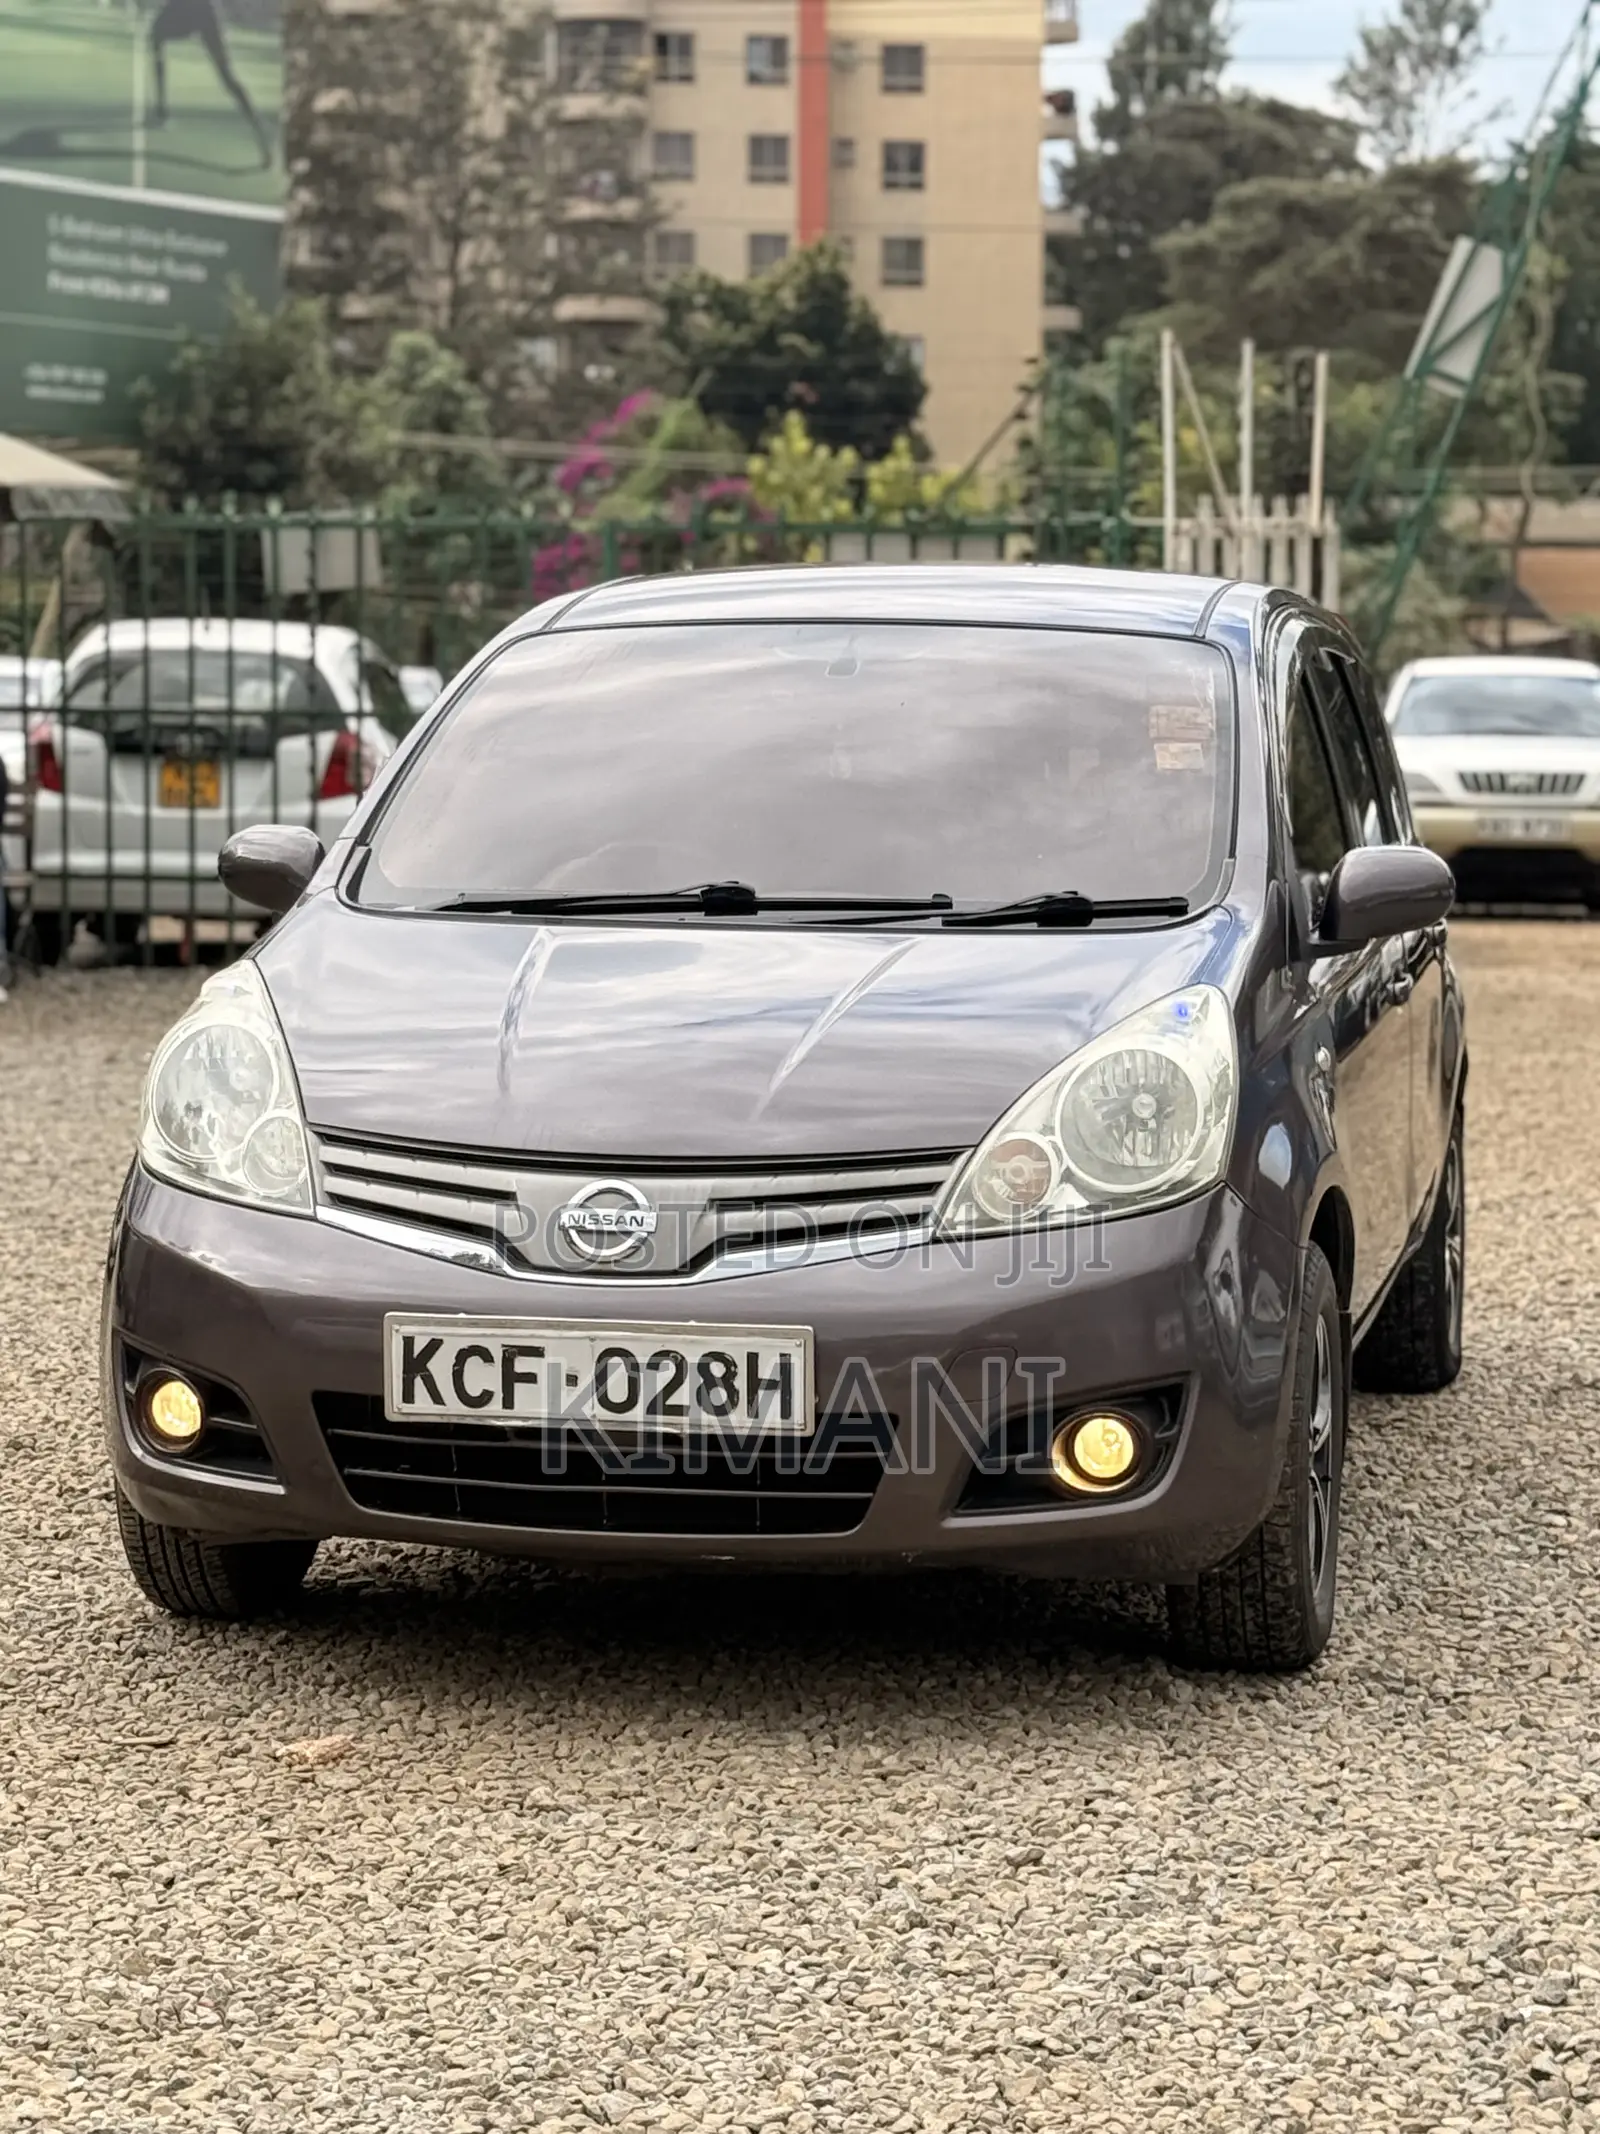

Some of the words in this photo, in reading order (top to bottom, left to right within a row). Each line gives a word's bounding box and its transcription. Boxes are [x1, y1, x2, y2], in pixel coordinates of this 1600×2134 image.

[567, 1213, 645, 1228] NISSAN
[401, 1335, 546, 1410] KCF
[594, 1346, 792, 1420] 028H
